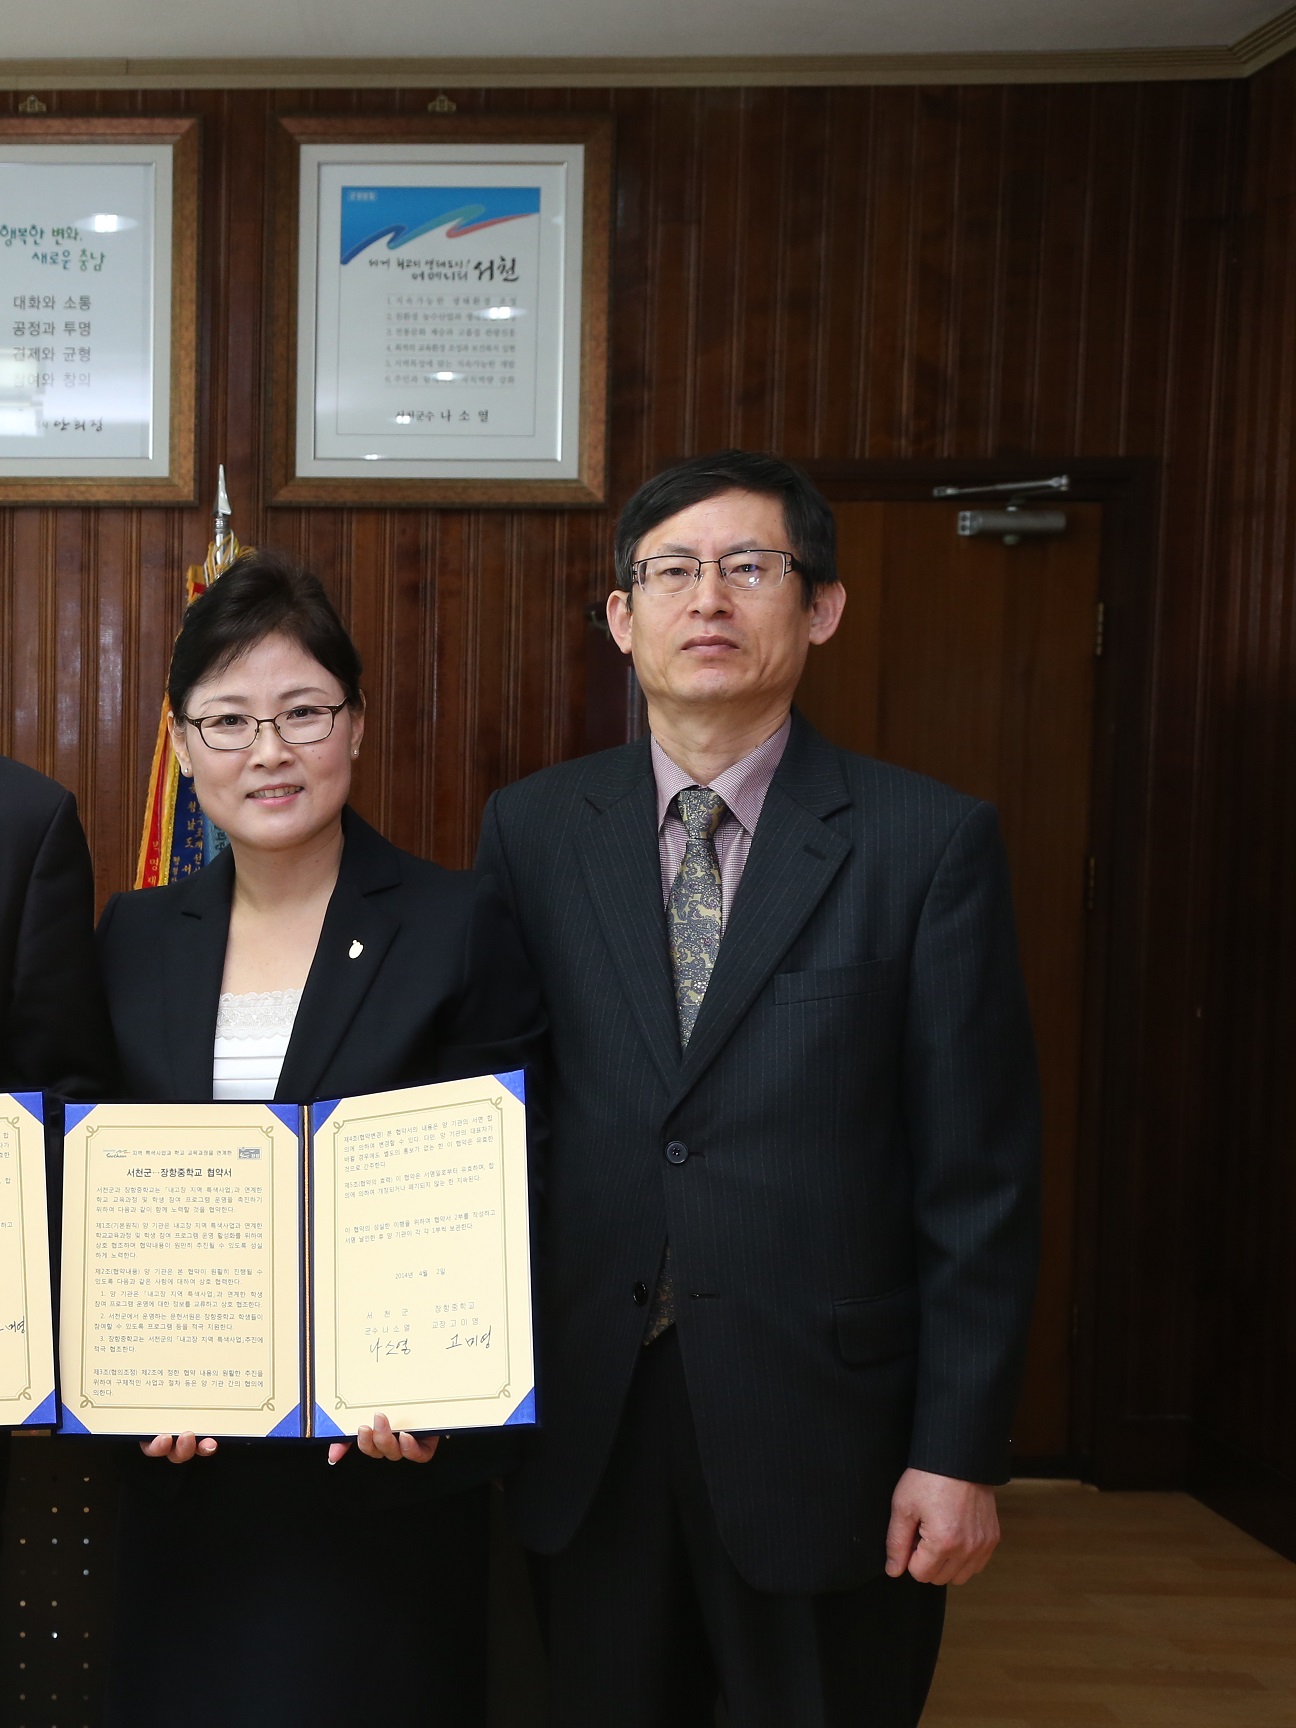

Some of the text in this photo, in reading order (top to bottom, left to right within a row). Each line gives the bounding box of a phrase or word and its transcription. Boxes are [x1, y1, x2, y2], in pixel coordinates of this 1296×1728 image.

[0, 224, 45, 247] 행복한
[31, 249, 105, 272] 새로운 충남
[474, 255, 519, 282] 서천
[13, 295, 92, 311] 대화와 소통
[12, 321, 91, 336] 공정과 투명
[63, 347, 91, 362] 균형
[63, 372, 91, 388] 창의
[127, 1168, 231, 1178] 서천군 장항중학교 협약서
